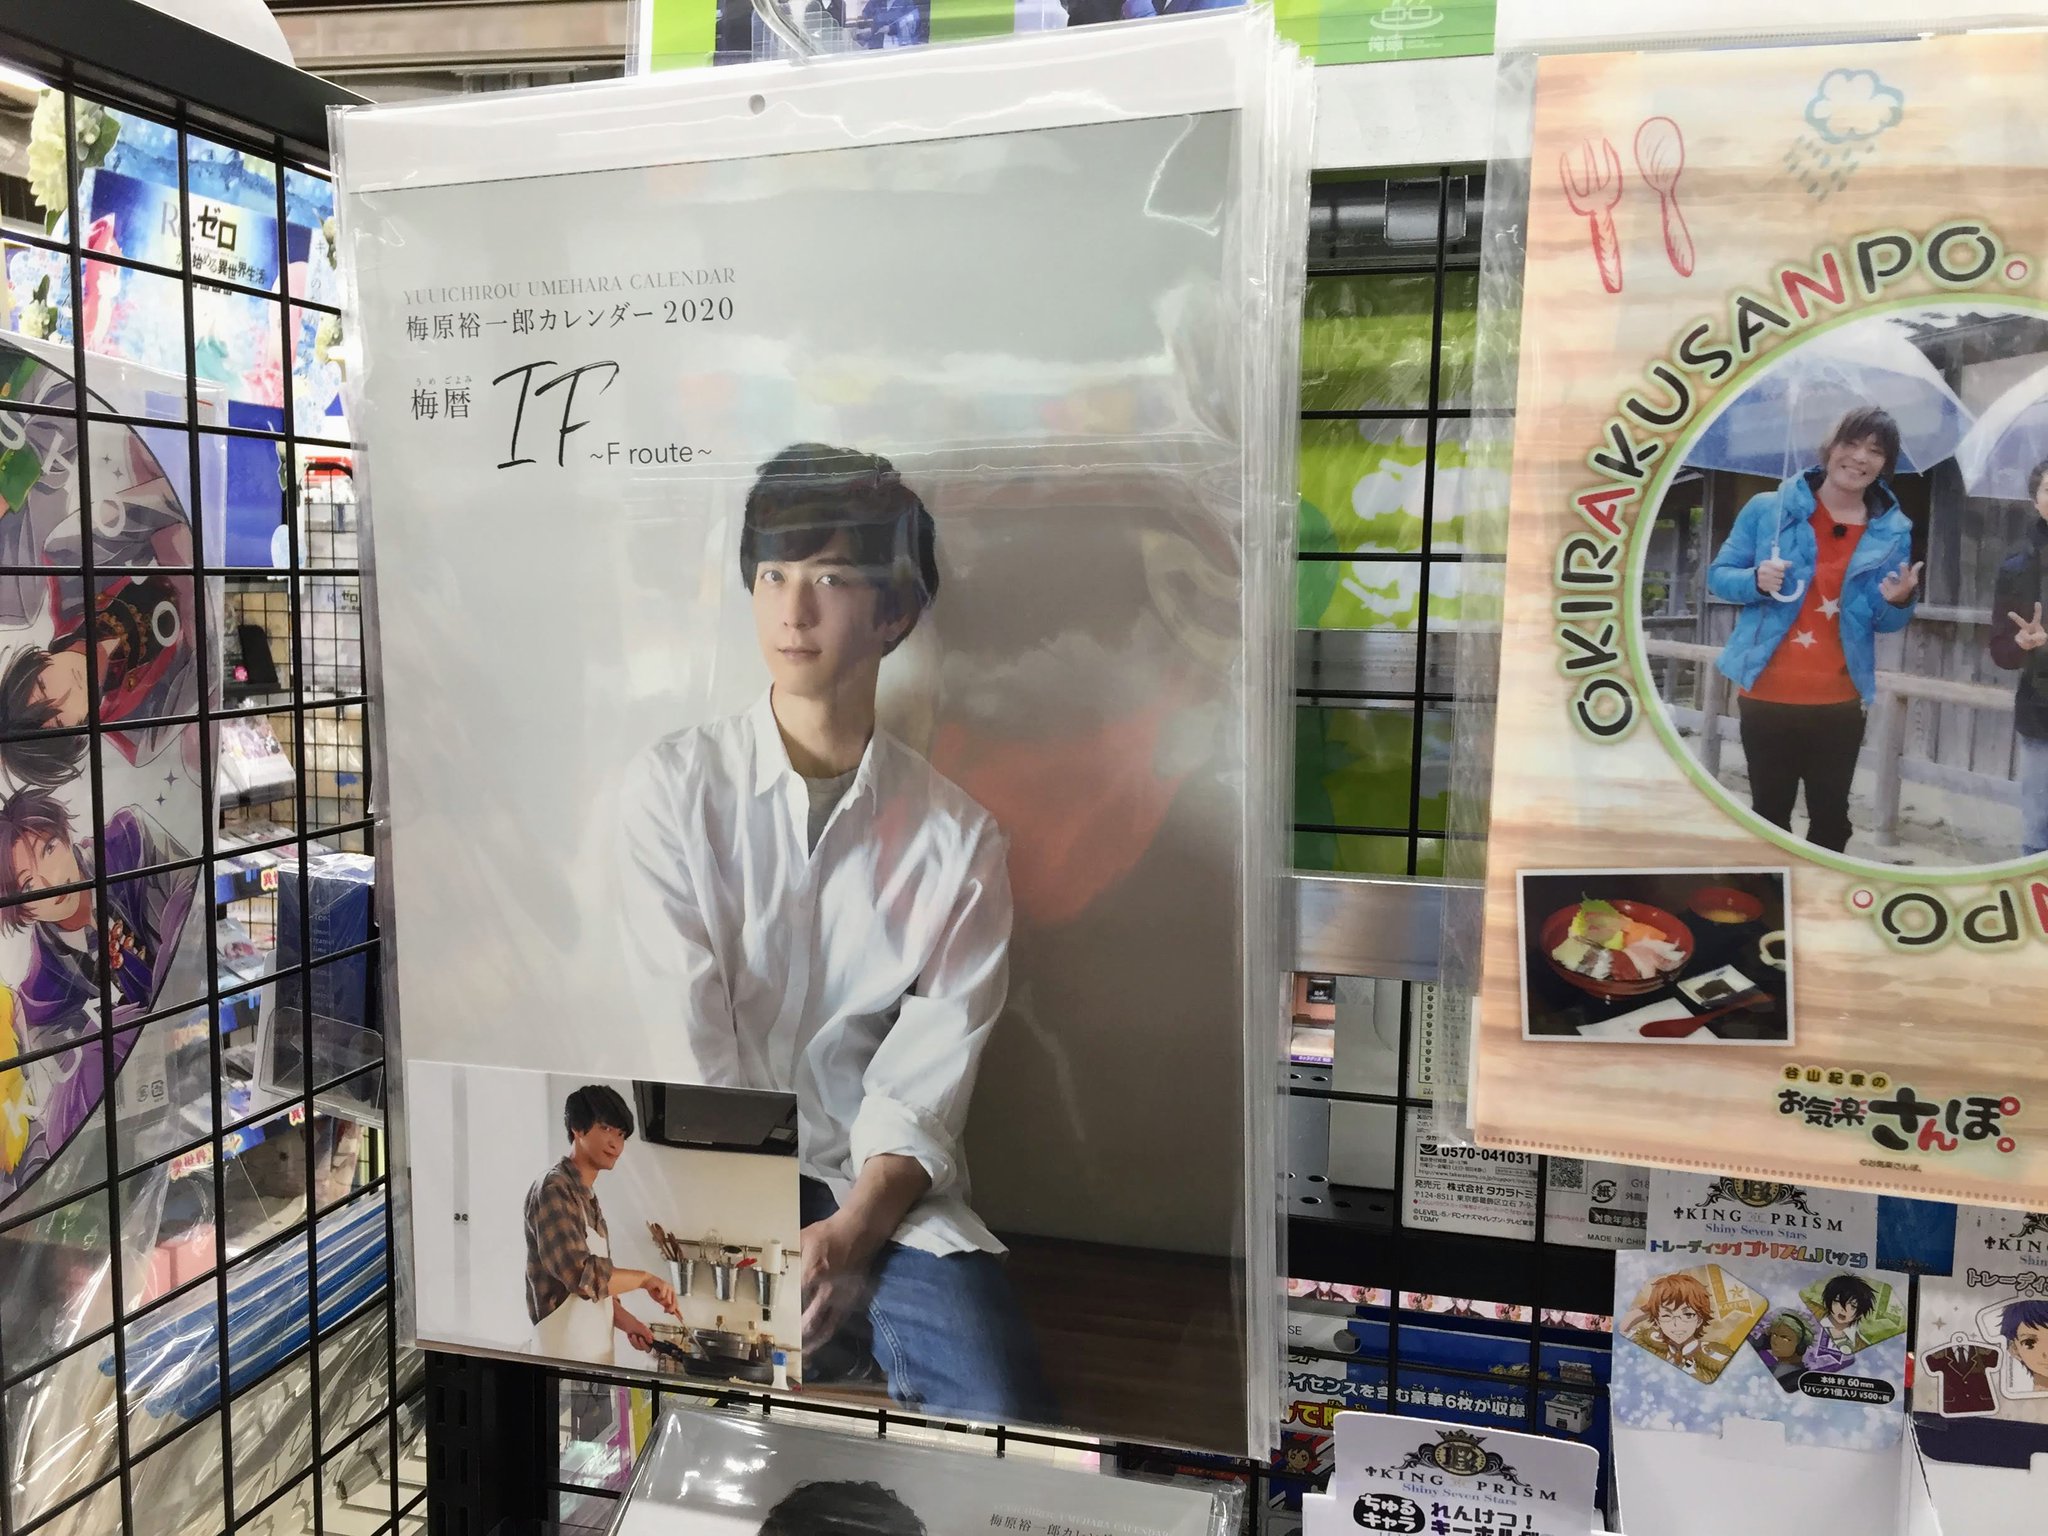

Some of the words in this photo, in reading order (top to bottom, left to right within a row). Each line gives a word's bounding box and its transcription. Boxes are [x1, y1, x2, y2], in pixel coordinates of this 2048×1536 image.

[404, 281, 520, 305] YUUICHIROU
[528, 272, 623, 297] UMEHARA
[630, 267, 736, 290] CALENDAR
[406, 301, 653, 342] 梅原裕一郎カレンダー
[662, 297, 735, 324] 2020
[411, 386, 471, 421] 梅暦
[1785, 1067, 1886, 1088] 谷山紀章の
[1441, 1147, 1532, 1165] 0570-041031
[1447, 1182, 1484, 1195] 株式会社
[1487, 1186, 1538, 1200] タカラトミ
[1686, 1207, 1743, 1223] KING
[1772, 1213, 1844, 1232] PRISM
[1587, 1233, 1612, 1243] MADE
[1705, 1222, 1737, 1238] Shiny
[1741, 1224, 1774, 1239] Seven
[1777, 1228, 1808, 1241] Stars
[1998, 1238, 2048, 1253] KIN
[1967, 1268, 2048, 1294] トレーディ
[1380, 1467, 1444, 1486] KING
[1477, 1481, 1557, 1501] PRISM
[1402, 1482, 1439, 1497] Shiny
[1442, 1487, 1479, 1501] Seven
[1484, 1493, 1517, 1506] Stars
[1360, 1493, 1415, 1514] ちゅる
[1363, 1512, 1416, 1532] キャラ
